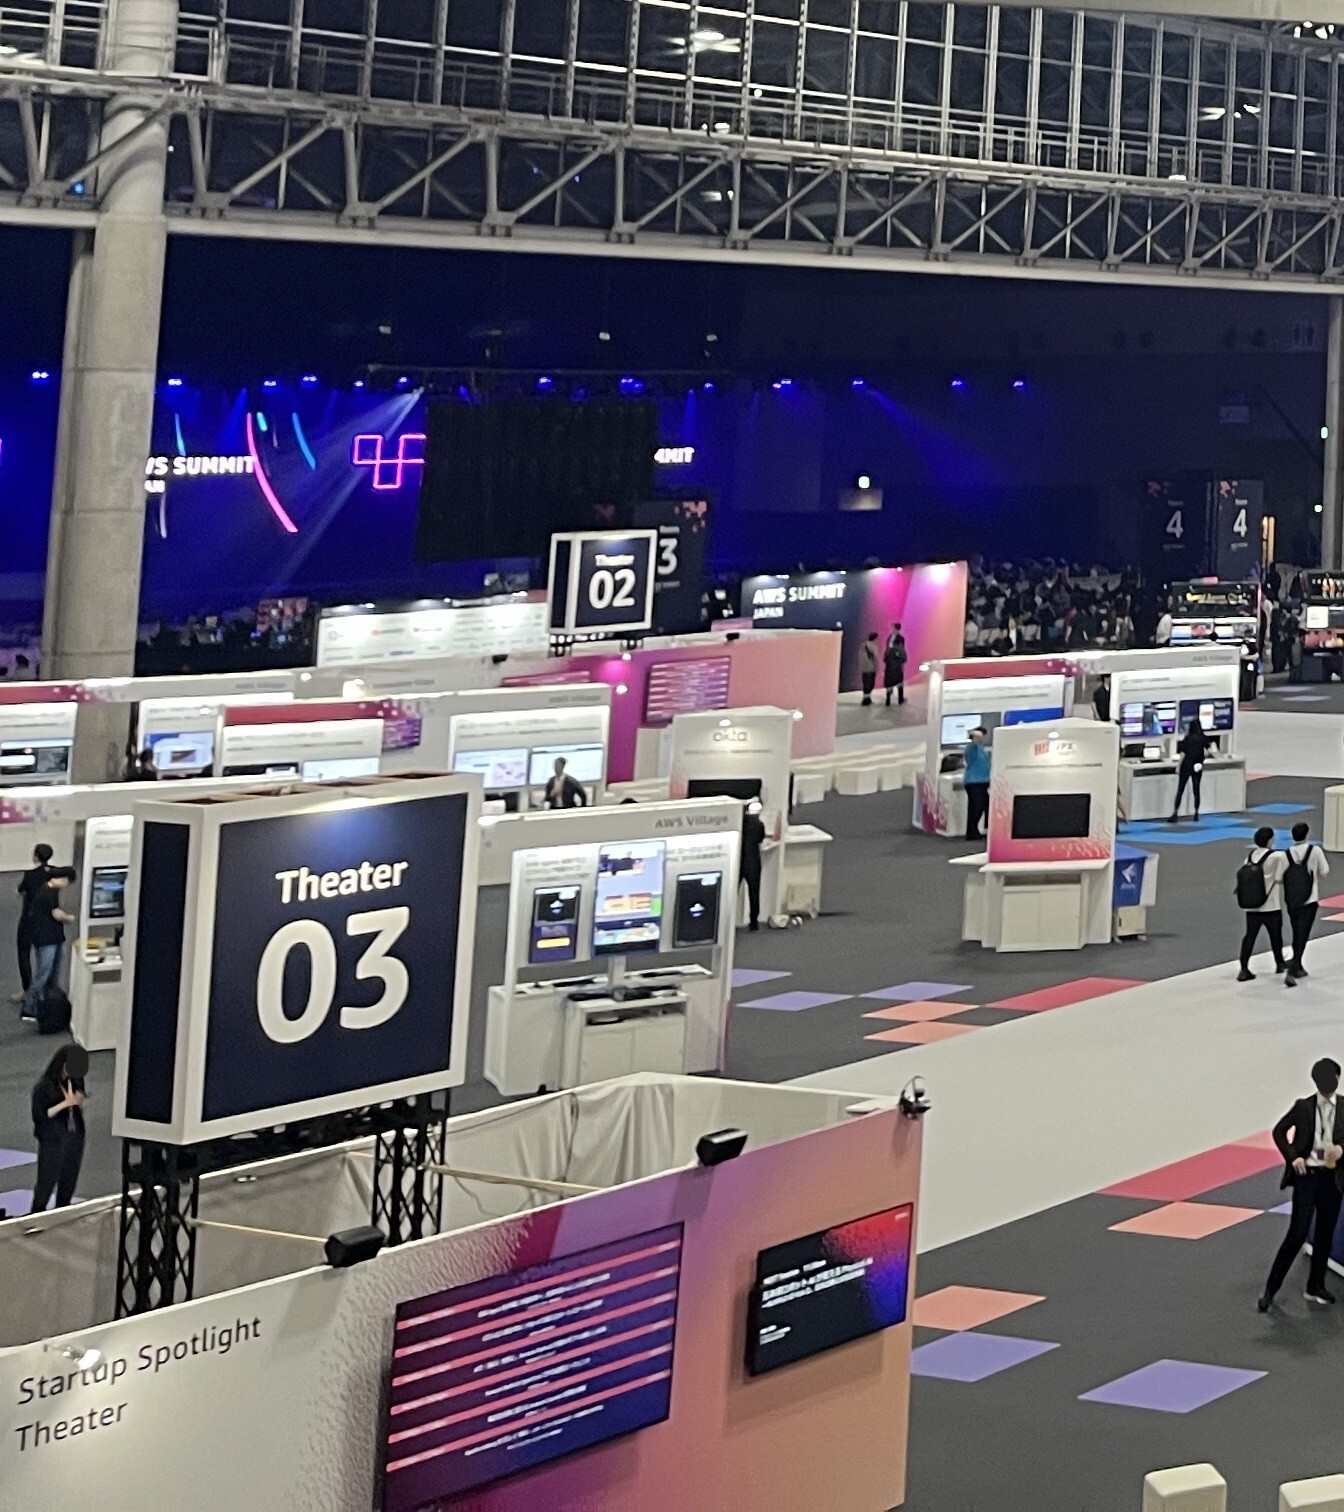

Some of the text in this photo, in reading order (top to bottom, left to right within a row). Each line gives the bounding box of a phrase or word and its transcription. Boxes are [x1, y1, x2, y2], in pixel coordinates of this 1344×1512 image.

[172, 456, 255, 475] SUMMIT
[1166, 510, 1184, 538] 4
[1233, 508, 1248, 537] 4
[657, 538, 678, 575] 3
[588, 568, 636, 609] 02
[752, 583, 846, 604] AWS SUMMIT
[712, 729, 748, 743] okta
[655, 813, 729, 830] AWS Village
[275, 861, 409, 904] Theater
[257, 906, 410, 1044] 03
[17, 1316, 262, 1405] Startup Spotlight
[15, 1402, 128, 1452] Theater
